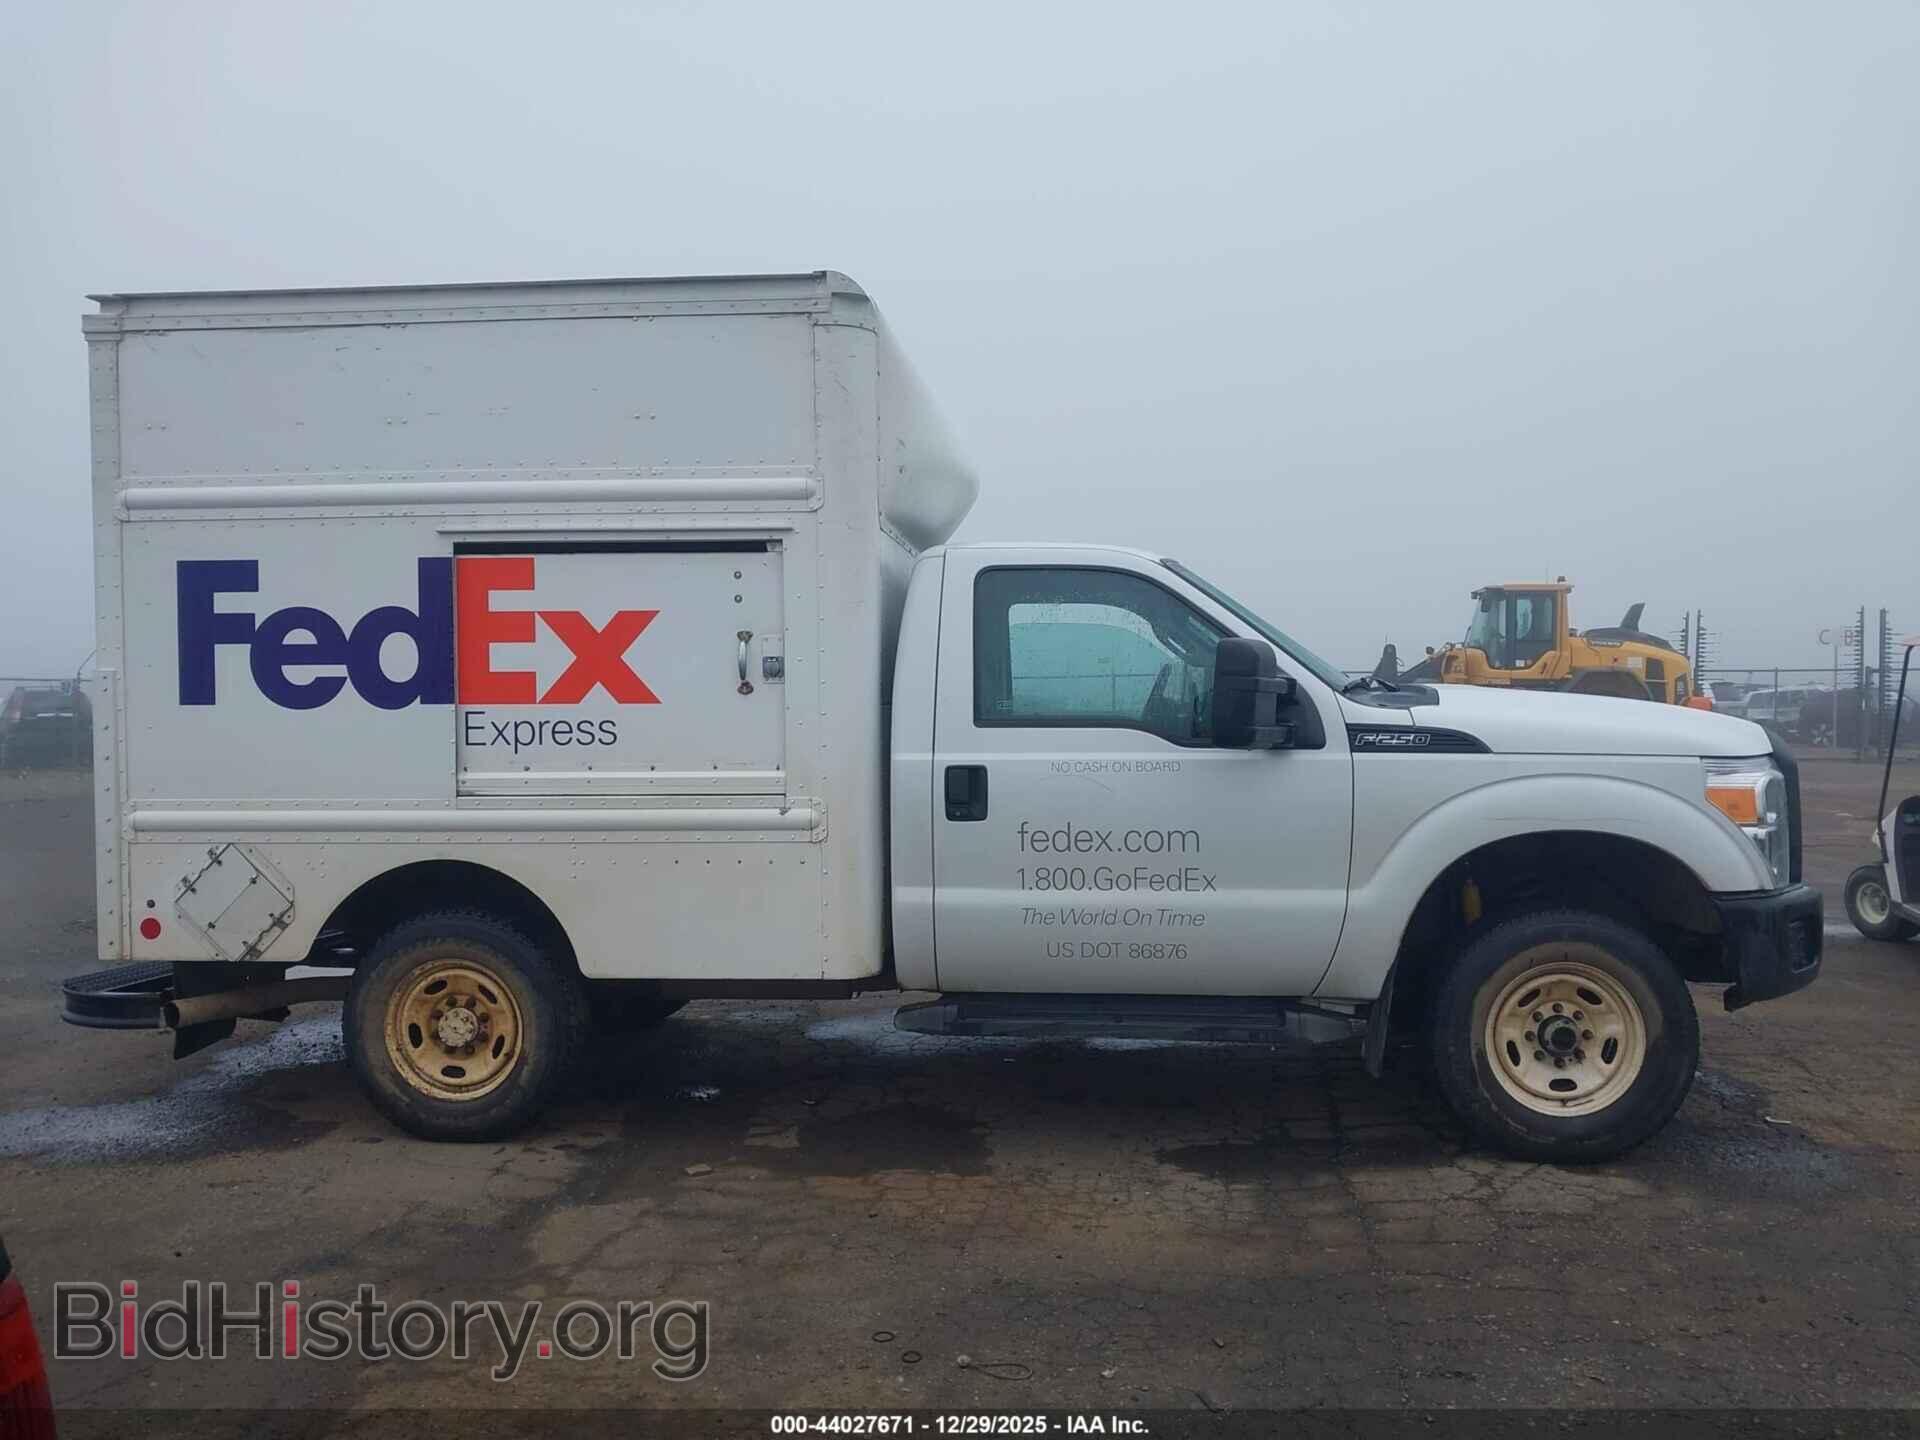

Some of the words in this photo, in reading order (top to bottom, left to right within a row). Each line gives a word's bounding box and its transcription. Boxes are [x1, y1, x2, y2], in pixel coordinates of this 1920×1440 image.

[177, 556, 662, 710] FedEx
[464, 711, 618, 754] Express
[1051, 761, 1071, 773] NO
[1074, 761, 1109, 773] CASH
[1112, 761, 1132, 773] ON
[1135, 761, 1182, 773] BOARD
[1017, 822, 1200, 852] fedex.com
[1017, 867, 1217, 892] 1.800.GoFedEx
[1021, 907, 1056, 926] The
[1060, 908, 1117, 926] World
[1122, 908, 1152, 926] On
[1157, 908, 1205, 927] Time
[1046, 942, 1074, 959] US
[1080, 942, 1121, 959] DOT
[1128, 943, 1188, 960] 86876
